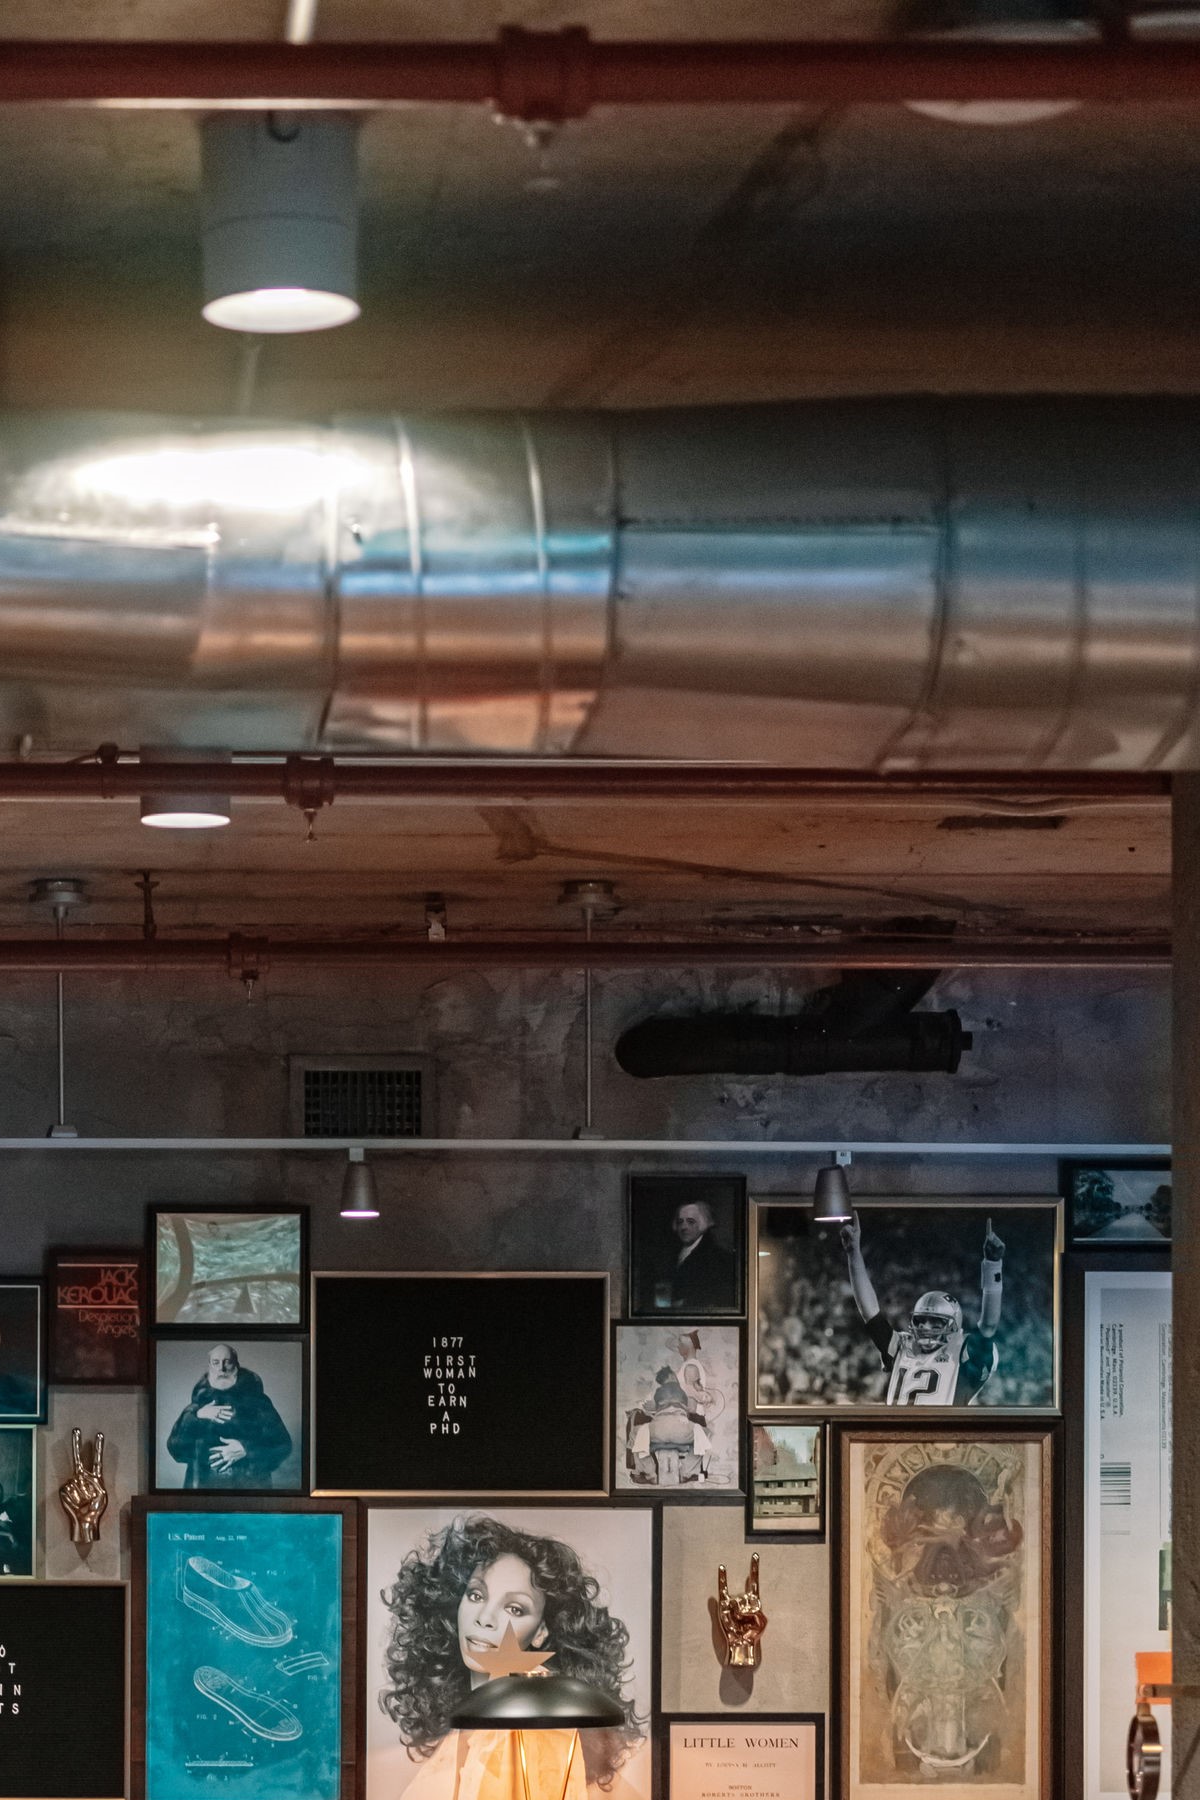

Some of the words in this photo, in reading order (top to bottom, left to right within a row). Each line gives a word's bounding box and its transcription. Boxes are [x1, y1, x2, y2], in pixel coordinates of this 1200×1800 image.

[99, 1268, 139, 1288] JACK
[57, 1286, 139, 1304] KEROUAC
[97, 1321, 137, 1338] Angels
[432, 1336, 464, 1349] 1877
[424, 1355, 476, 1367] FIRST
[423, 1366, 476, 1379] WOMAN
[438, 1382, 456, 1395] TO
[892, 1366, 942, 1406] 12
[427, 1395, 468, 1408] EARN
[442, 1410, 450, 1422] A
[429, 1422, 461, 1435] PHD
[183, 1532, 205, 1541] Patent
[683, 1737, 736, 1749] LITTLE
[745, 1737, 799, 1749] WOMEN
